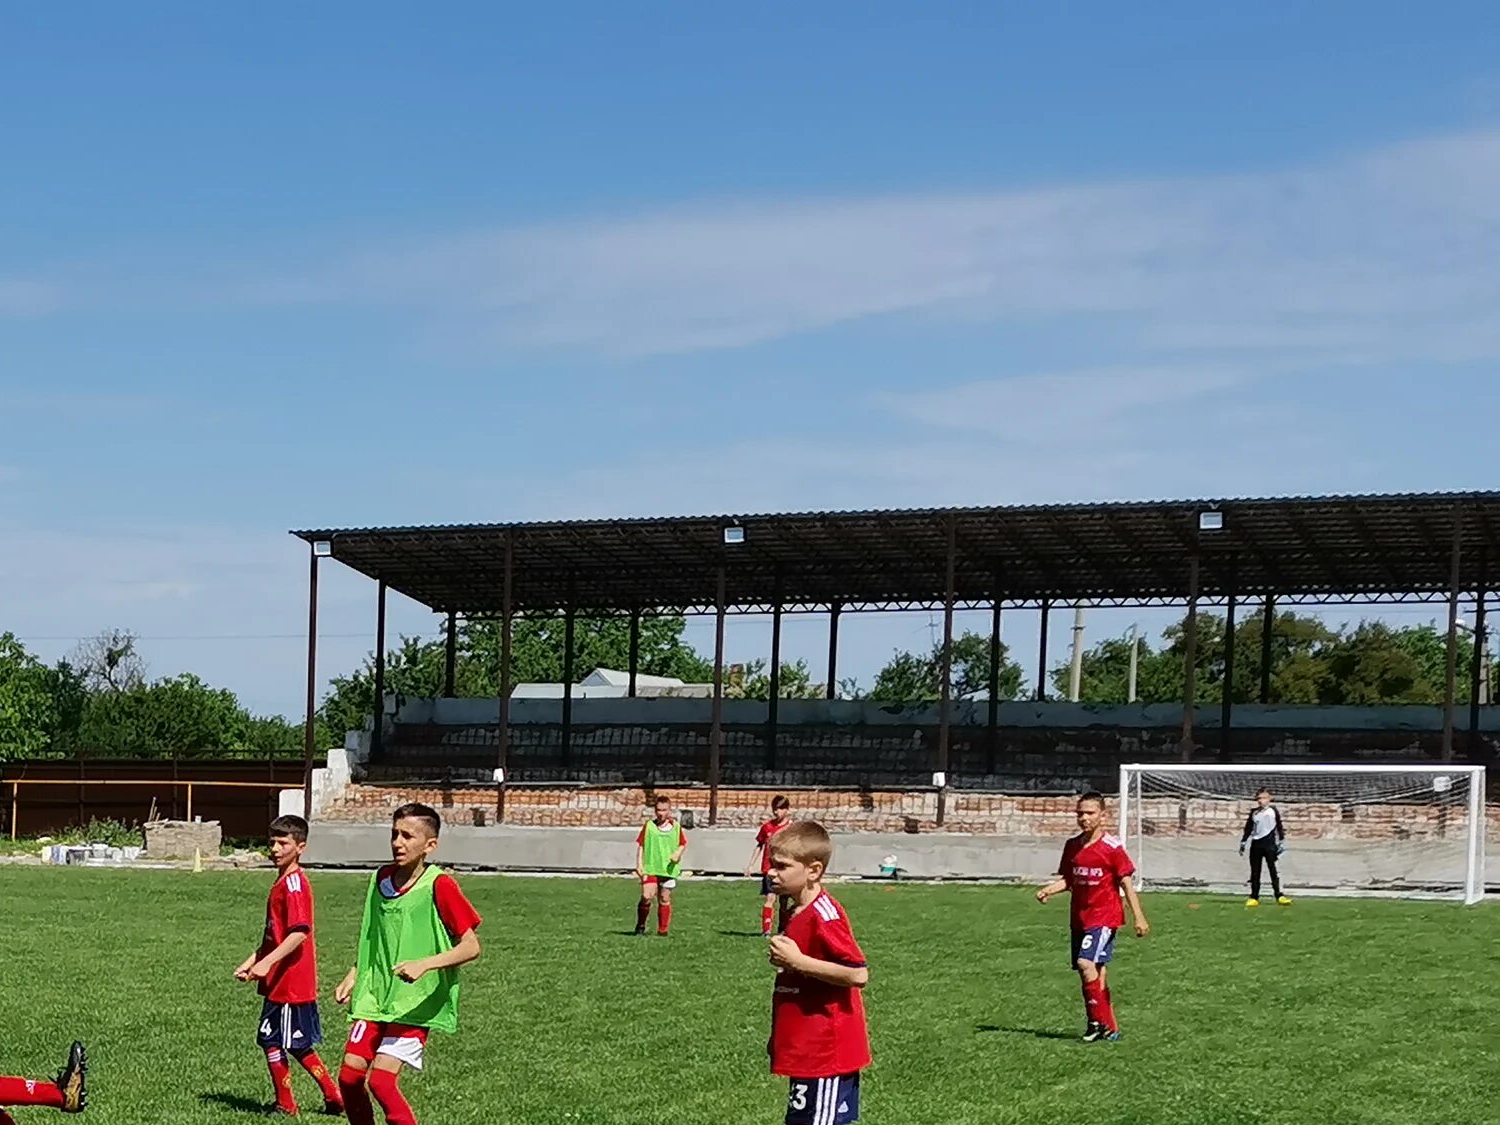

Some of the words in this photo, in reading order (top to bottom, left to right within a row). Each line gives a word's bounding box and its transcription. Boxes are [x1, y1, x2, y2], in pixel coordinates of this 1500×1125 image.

[1081, 934, 1093, 950] 6
[260, 1018, 272, 1036] 4
[350, 1020, 367, 1043] 0
[790, 1083, 808, 1110] 3
